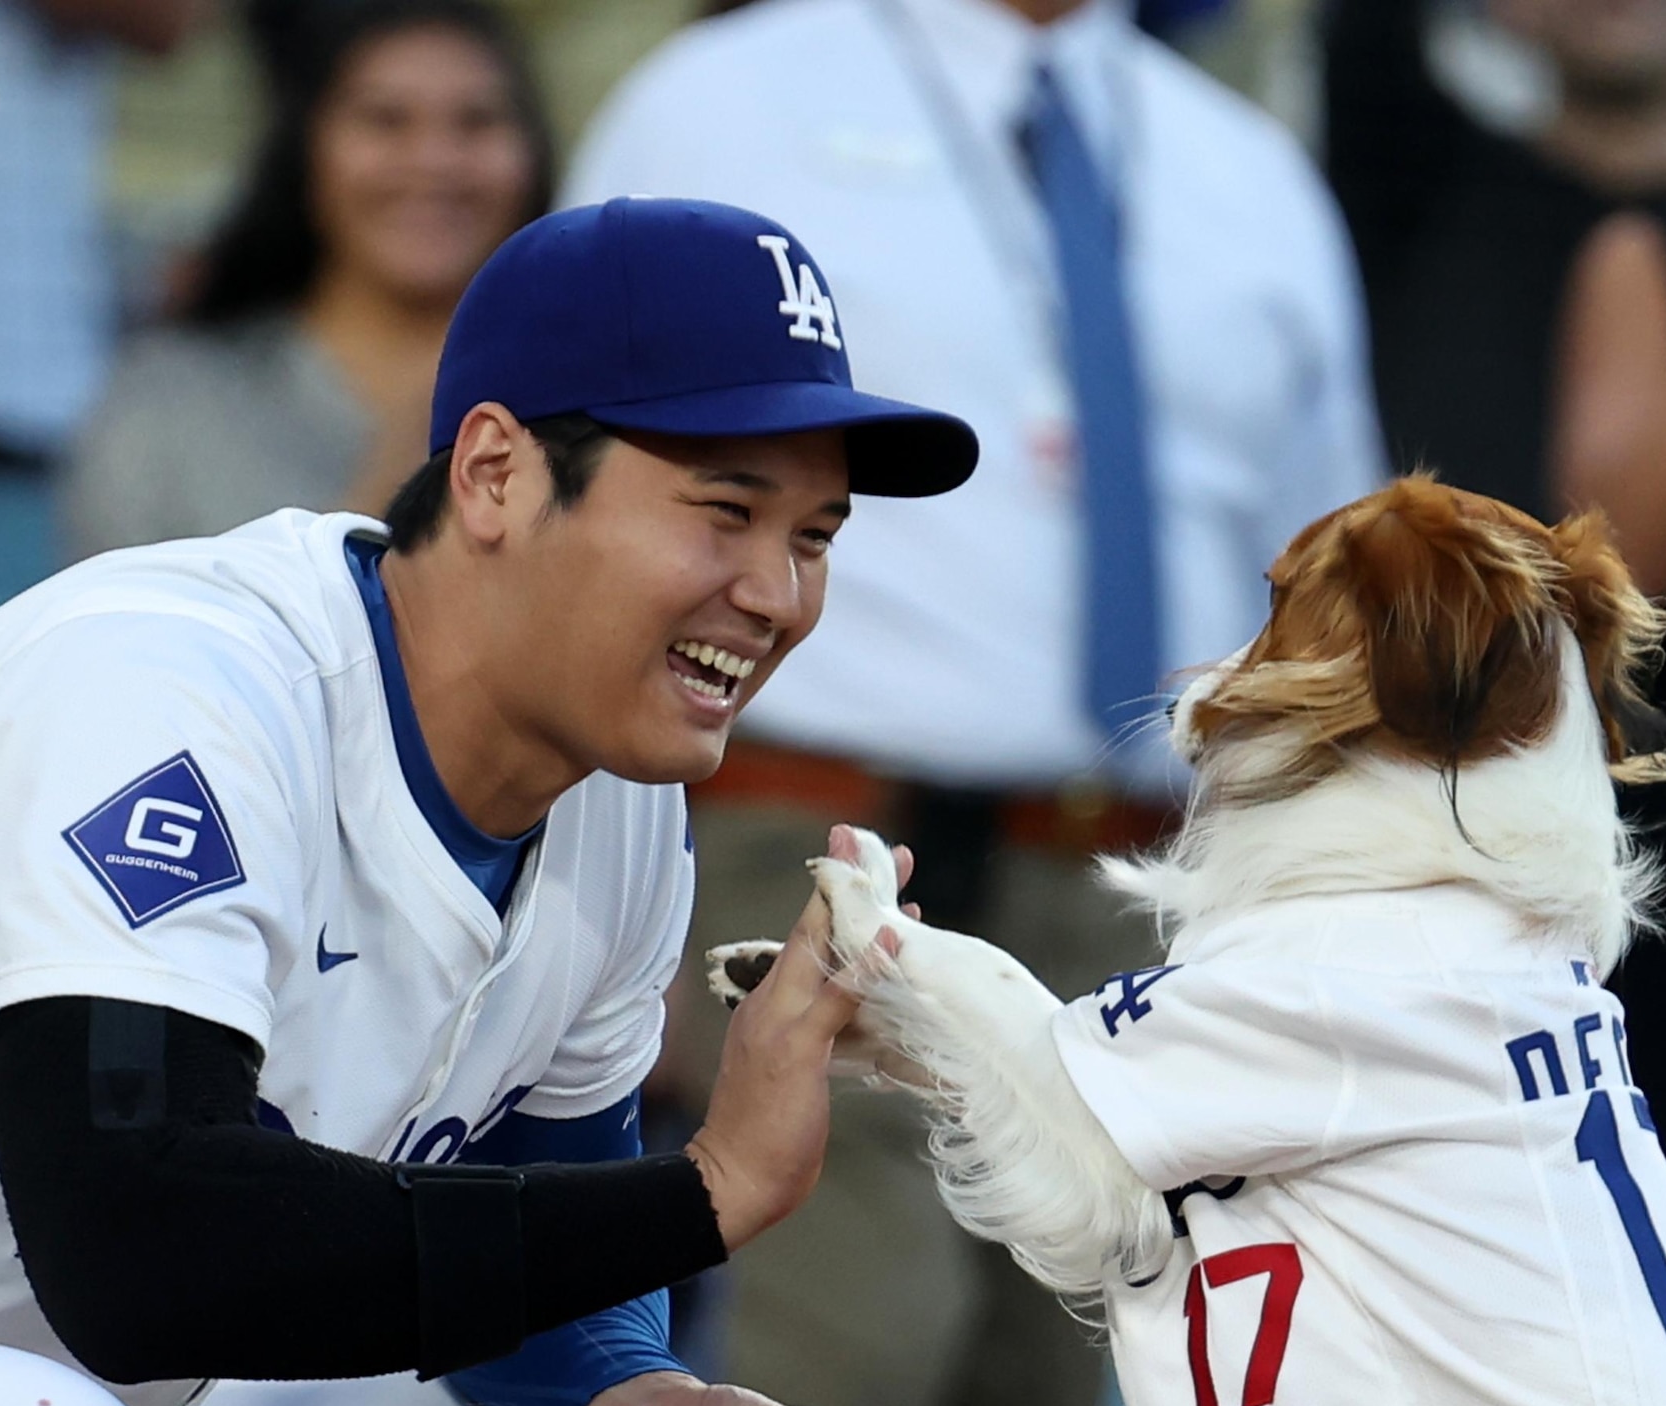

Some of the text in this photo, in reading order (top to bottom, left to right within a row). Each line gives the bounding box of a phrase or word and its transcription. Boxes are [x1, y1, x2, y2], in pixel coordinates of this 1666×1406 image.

[756, 234, 841, 351] LA
[124, 796, 204, 859] G
[105, 853, 200, 882] GUGGENHEIM
